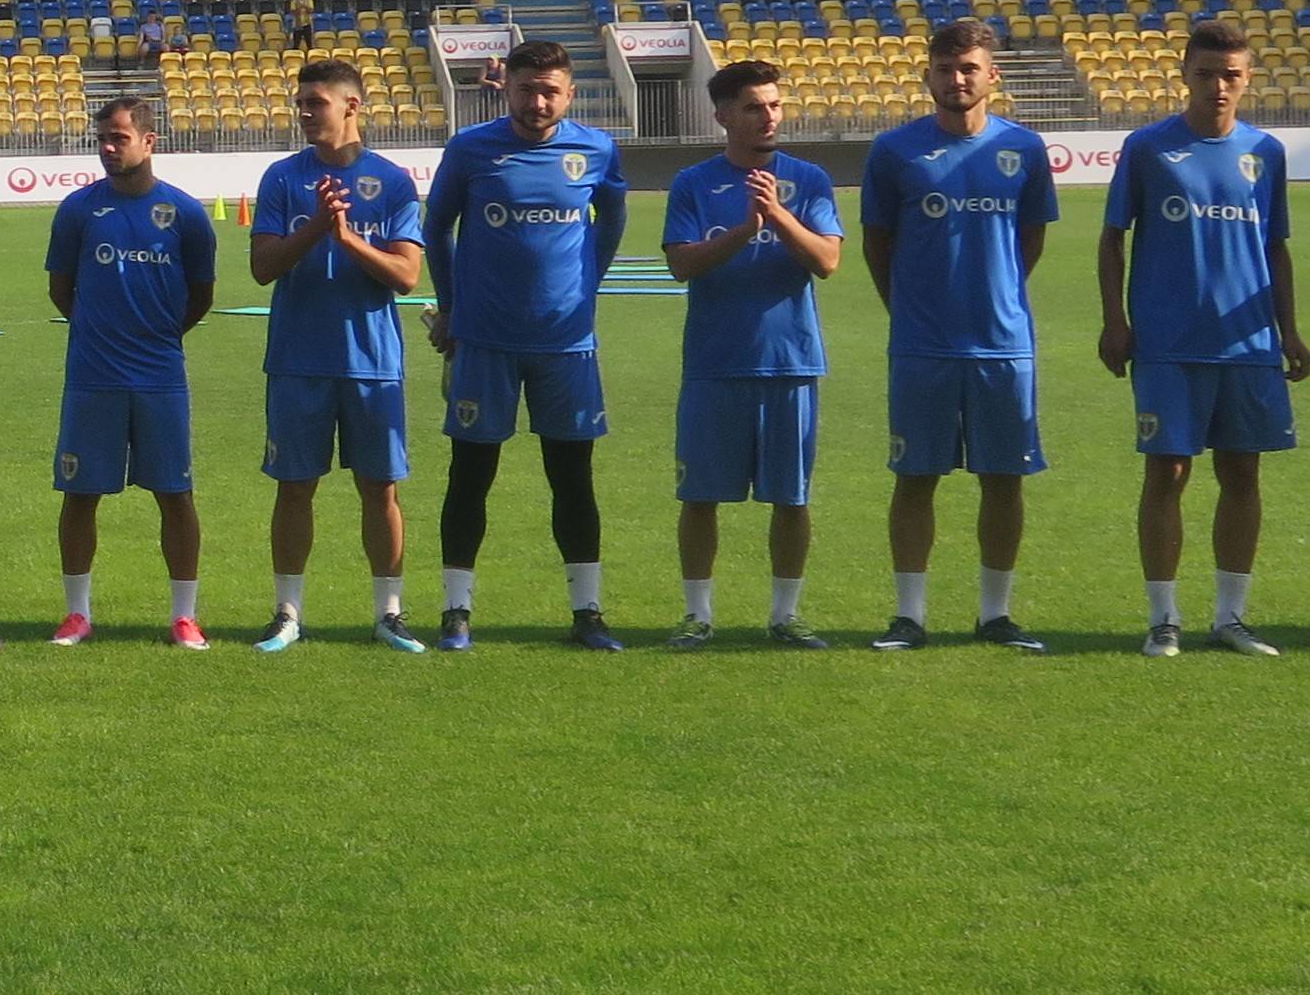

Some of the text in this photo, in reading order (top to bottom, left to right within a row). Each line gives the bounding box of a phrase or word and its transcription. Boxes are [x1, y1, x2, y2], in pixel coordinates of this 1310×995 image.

[461, 41, 507, 51] VEOLIA
[640, 38, 686, 49] VEOLIA
[40, 172, 95, 187] VEO
[511, 208, 581, 223] VEOLIA
[117, 249, 171, 265] VEOLIA
